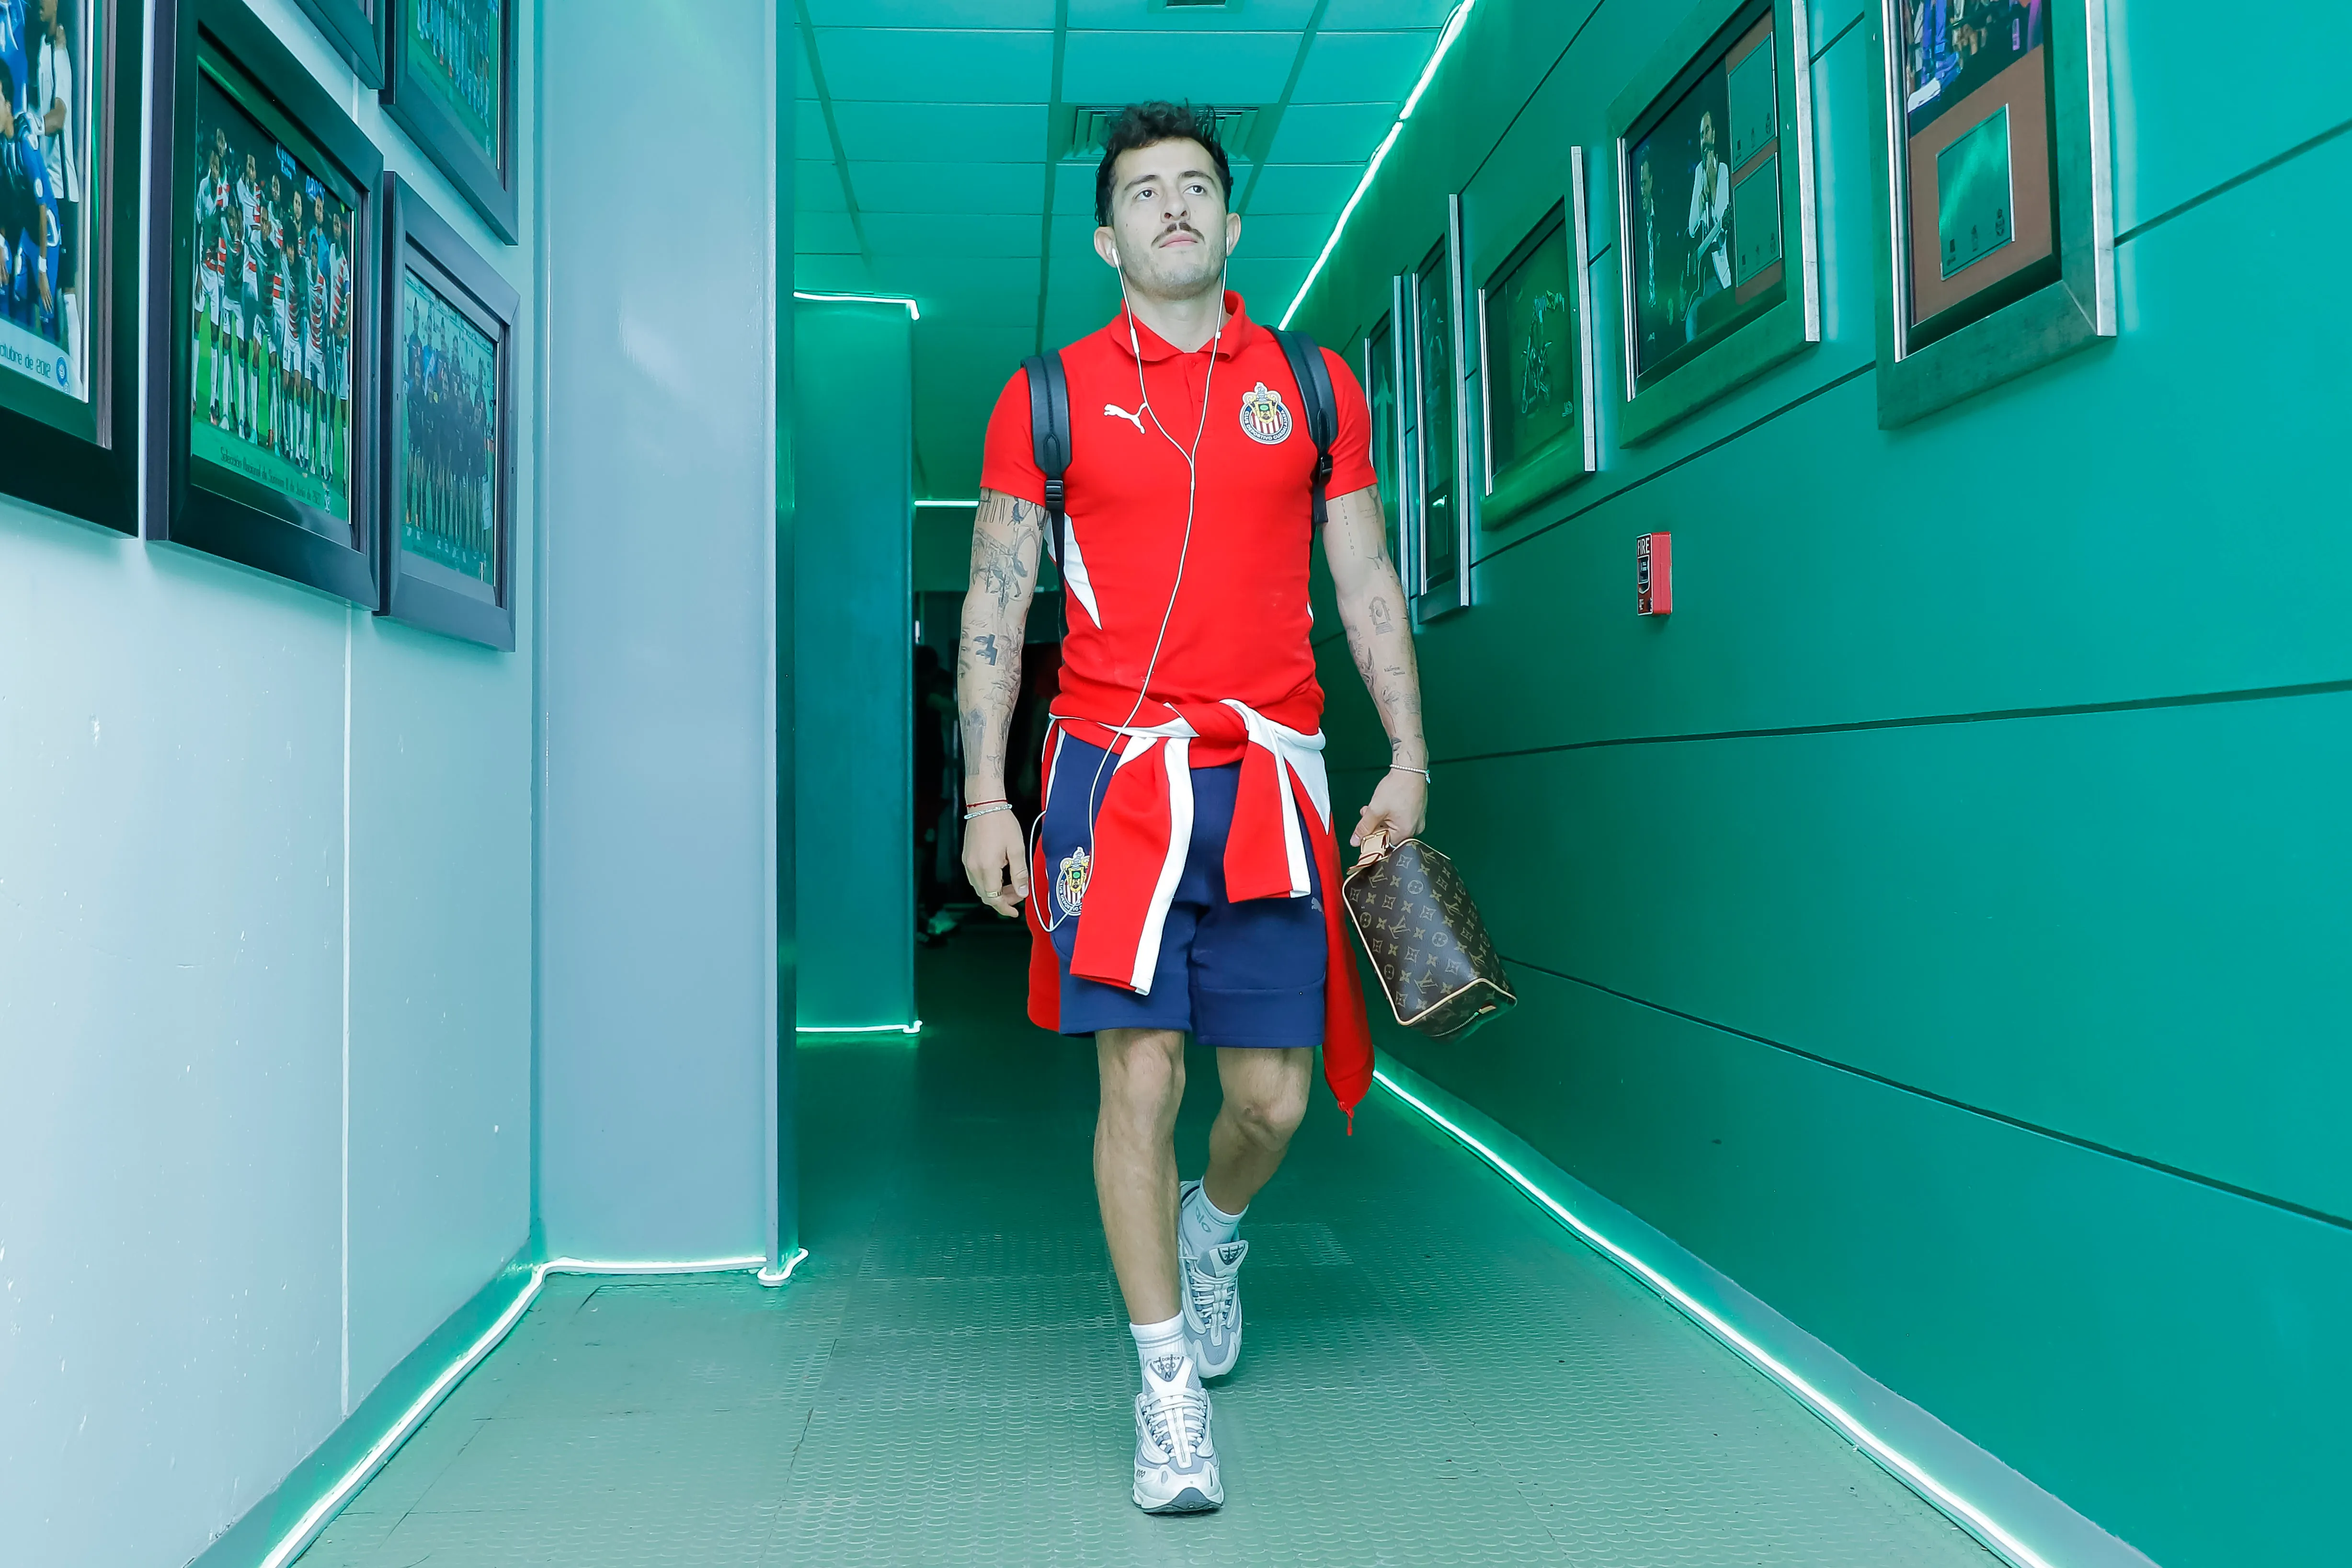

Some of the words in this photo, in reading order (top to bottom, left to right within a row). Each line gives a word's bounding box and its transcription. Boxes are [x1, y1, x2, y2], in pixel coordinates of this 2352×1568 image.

[25, 355, 34, 370] de
[36, 359, 51, 378] 2012
[1246, 424, 1273, 440] DEPORTIVO
[1273, 410, 1288, 440] GUADALAJARA
[262, 466, 268, 481] de
[1637, 538, 1650, 556] FIRE
[1196, 1206, 1211, 1233] alo
